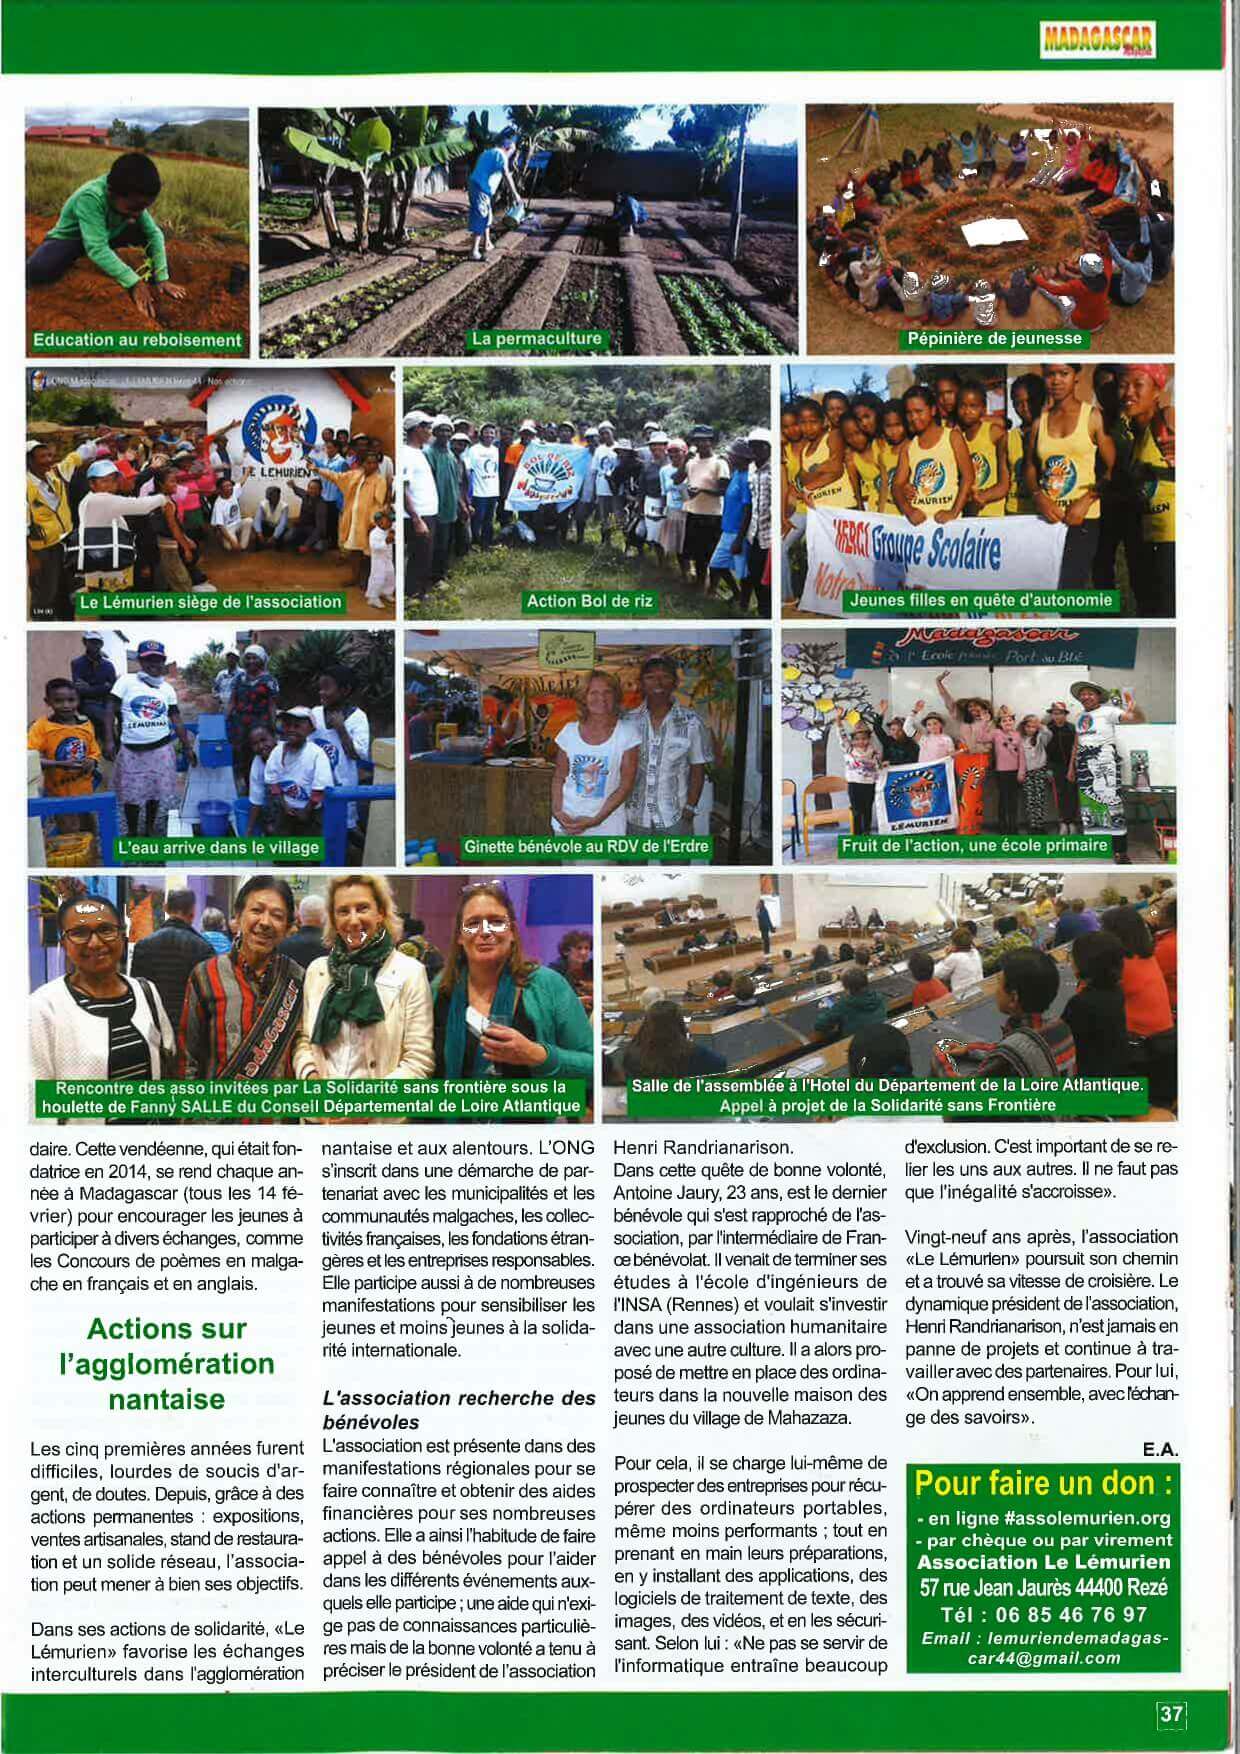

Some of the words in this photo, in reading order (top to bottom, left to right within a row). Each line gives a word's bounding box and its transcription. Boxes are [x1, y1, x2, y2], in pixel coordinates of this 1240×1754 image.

[1045, 26, 1152, 51] MADAGASCAR
[34, 333, 113, 346] Education
[119, 336, 137, 345] au
[144, 333, 241, 346] reboisement
[473, 332, 490, 345] La
[497, 332, 601, 348] permaculture
[909, 331, 982, 347] Pépinière
[989, 332, 1007, 344] de
[1011, 332, 1082, 347] jeunesse
[834, 519, 870, 558] MERCI
[872, 524, 924, 570] Groupe
[928, 527, 1002, 570] Scolaire
[81, 596, 98, 608] Le
[104, 596, 173, 608] Lémurien
[179, 595, 217, 611] siège
[223, 596, 240, 608] de
[247, 596, 341, 608] l'association
[528, 595, 576, 607] Action
[582, 595, 606, 607] Bol
[612, 595, 629, 607] de
[635, 595, 652, 607] riz
[851, 594, 904, 606] Jeunes
[911, 593, 945, 606] filles
[951, 597, 968, 606] en
[974, 593, 1015, 609] quête
[1020, 593, 1112, 606] d'autonomie
[119, 842, 158, 854] L'eau
[164, 842, 205, 853] arrive
[211, 841, 246, 853] dans
[253, 842, 264, 853] le
[270, 841, 318, 856] village
[465, 840, 514, 853] Ginette
[519, 840, 582, 852] bénévole
[586, 843, 603, 852] au
[608, 840, 638, 852] RDV
[643, 840, 659, 852] de
[664, 840, 708, 852] l'Erdre
[843, 839, 877, 851] Fruit
[883, 840, 900, 851] de
[906, 839, 963, 852] l'action,
[970, 842, 996, 851] une
[1002, 839, 1041, 851] école
[1047, 839, 1107, 854] primaire
[57, 1082, 133, 1094] Rencontre
[139, 1082, 165, 1094] des
[171, 1085, 204, 1095] asso
[211, 1081, 268, 1094] invitées
[274, 1084, 298, 1097] par
[304, 1081, 321, 1094] La
[327, 1081, 398, 1093] Solidarité
[404, 1084, 439, 1093] sans
[444, 1080, 506, 1093] frontière
[512, 1083, 548, 1093] sous
[554, 1080, 565, 1093] la
[632, 1079, 668, 1092] Salle
[674, 1079, 691, 1092] de
[697, 1079, 784, 1092] l'assemblée
[789, 1079, 797, 1092] à
[803, 1079, 849, 1091] l'Hotel
[855, 1079, 873, 1091] du
[879, 1079, 976, 1094] Département
[980, 1079, 998, 1091] de
[1004, 1079, 1015, 1091] la
[1021, 1079, 1058, 1091] Loire
[1063, 1079, 1143, 1094] Atlantique.
[43, 1101, 103, 1113] houlette
[109, 1101, 126, 1113] de
[131, 1100, 176, 1116] Fanny
[182, 1100, 232, 1113] SALLE
[238, 1100, 256, 1112] du
[262, 1100, 318, 1112] Conseil
[324, 1099, 433, 1115] Départemental
[439, 1100, 456, 1112] de
[462, 1099, 498, 1112] Loire
[503, 1099, 580, 1115] Atlantique
[720, 1100, 763, 1115] Appel
[769, 1099, 776, 1112] à
[782, 1099, 825, 1115] projet
[830, 1099, 848, 1111] de
[854, 1099, 865, 1111] la
[871, 1099, 943, 1111] Solidarité
[948, 1102, 983, 1111] sans
[989, 1098, 1056, 1111] Frontière
[614, 1140, 657, 1154] Henri
[664, 1140, 793, 1154] Randrianarison.
[87, 1317, 192, 1339] Actions
[202, 1323, 247, 1339] sur
[61, 1352, 274, 1381] l'agglomération
[110, 1388, 225, 1410] nantaise
[323, 1390, 450, 1405] L'association
[458, 1390, 554, 1405] recherche
[562, 1390, 595, 1405] des
[323, 1414, 419, 1430] bénévoles
[1144, 1442, 1178, 1456] E.A.
[916, 1470, 981, 1495] Pour
[990, 1469, 1049, 1495] faire
[1060, 1476, 1092, 1495] un
[1103, 1470, 1154, 1494] don
[929, 1515, 949, 1525] en
[957, 1511, 999, 1529] ligne
[1005, 1511, 1170, 1528] #assolemurien.org
[928, 1537, 956, 1550] par
[962, 1533, 1026, 1550] chèque
[1033, 1537, 1054, 1546] ou
[1061, 1537, 1089, 1550] par
[1094, 1533, 1172, 1546] virement
[917, 1555, 1037, 1569] Association
[1045, 1555, 1068, 1569] Le
[1076, 1554, 1170, 1569] Lémurien
[920, 1578, 939, 1596] 57
[944, 1583, 969, 1596] rue
[974, 1578, 1013, 1596] Jean
[1017, 1578, 1071, 1596] Jaurès
[1076, 1578, 1123, 1596] 44400
[1128, 1577, 1168, 1596] Rezé
[941, 1607, 972, 1623] Tél
[996, 1607, 1019, 1622] 06
[1028, 1607, 1051, 1622] 85
[1060, 1607, 1083, 1622] 46
[1091, 1607, 1115, 1622] 76
[1124, 1607, 1147, 1622] 97
[922, 1632, 970, 1644] Email
[988, 1631, 1168, 1647] lemuriendemadagas-
[968, 1651, 1120, 1668] car44@gmail.com
[32, 1667, 137, 1681] interculturels
[144, 1667, 183, 1681] dans
[191, 1666, 304, 1684] l'agglomération
[1161, 1706, 1183, 1722] 37
